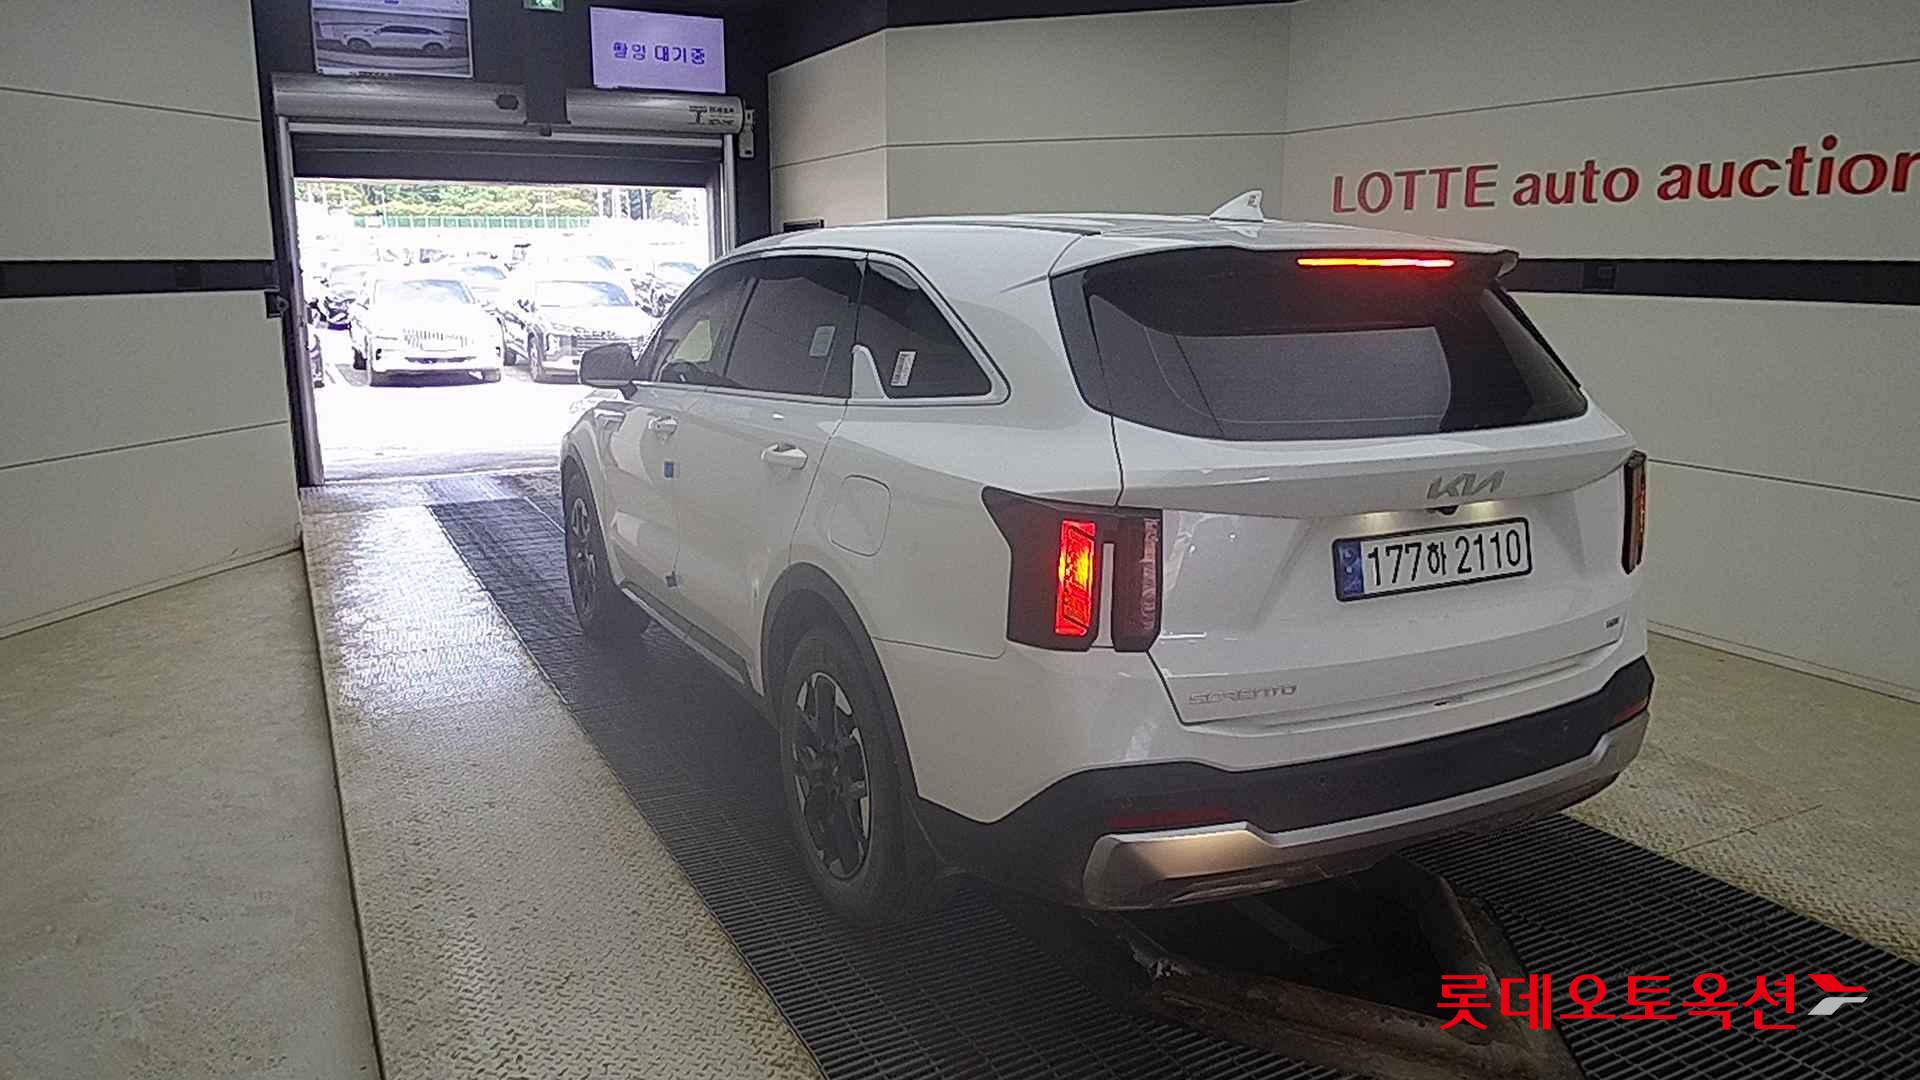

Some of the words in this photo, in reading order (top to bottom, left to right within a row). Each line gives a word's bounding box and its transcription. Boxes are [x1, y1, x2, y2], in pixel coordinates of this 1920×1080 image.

[654, 44, 705, 65] 대기중
[1330, 163, 1500, 214] LOTTE
[1512, 159, 1640, 207] auto
[1426, 470, 1505, 499] KIA
[1368, 541, 1447, 587] 177하
[1455, 529, 1521, 575] 2110
